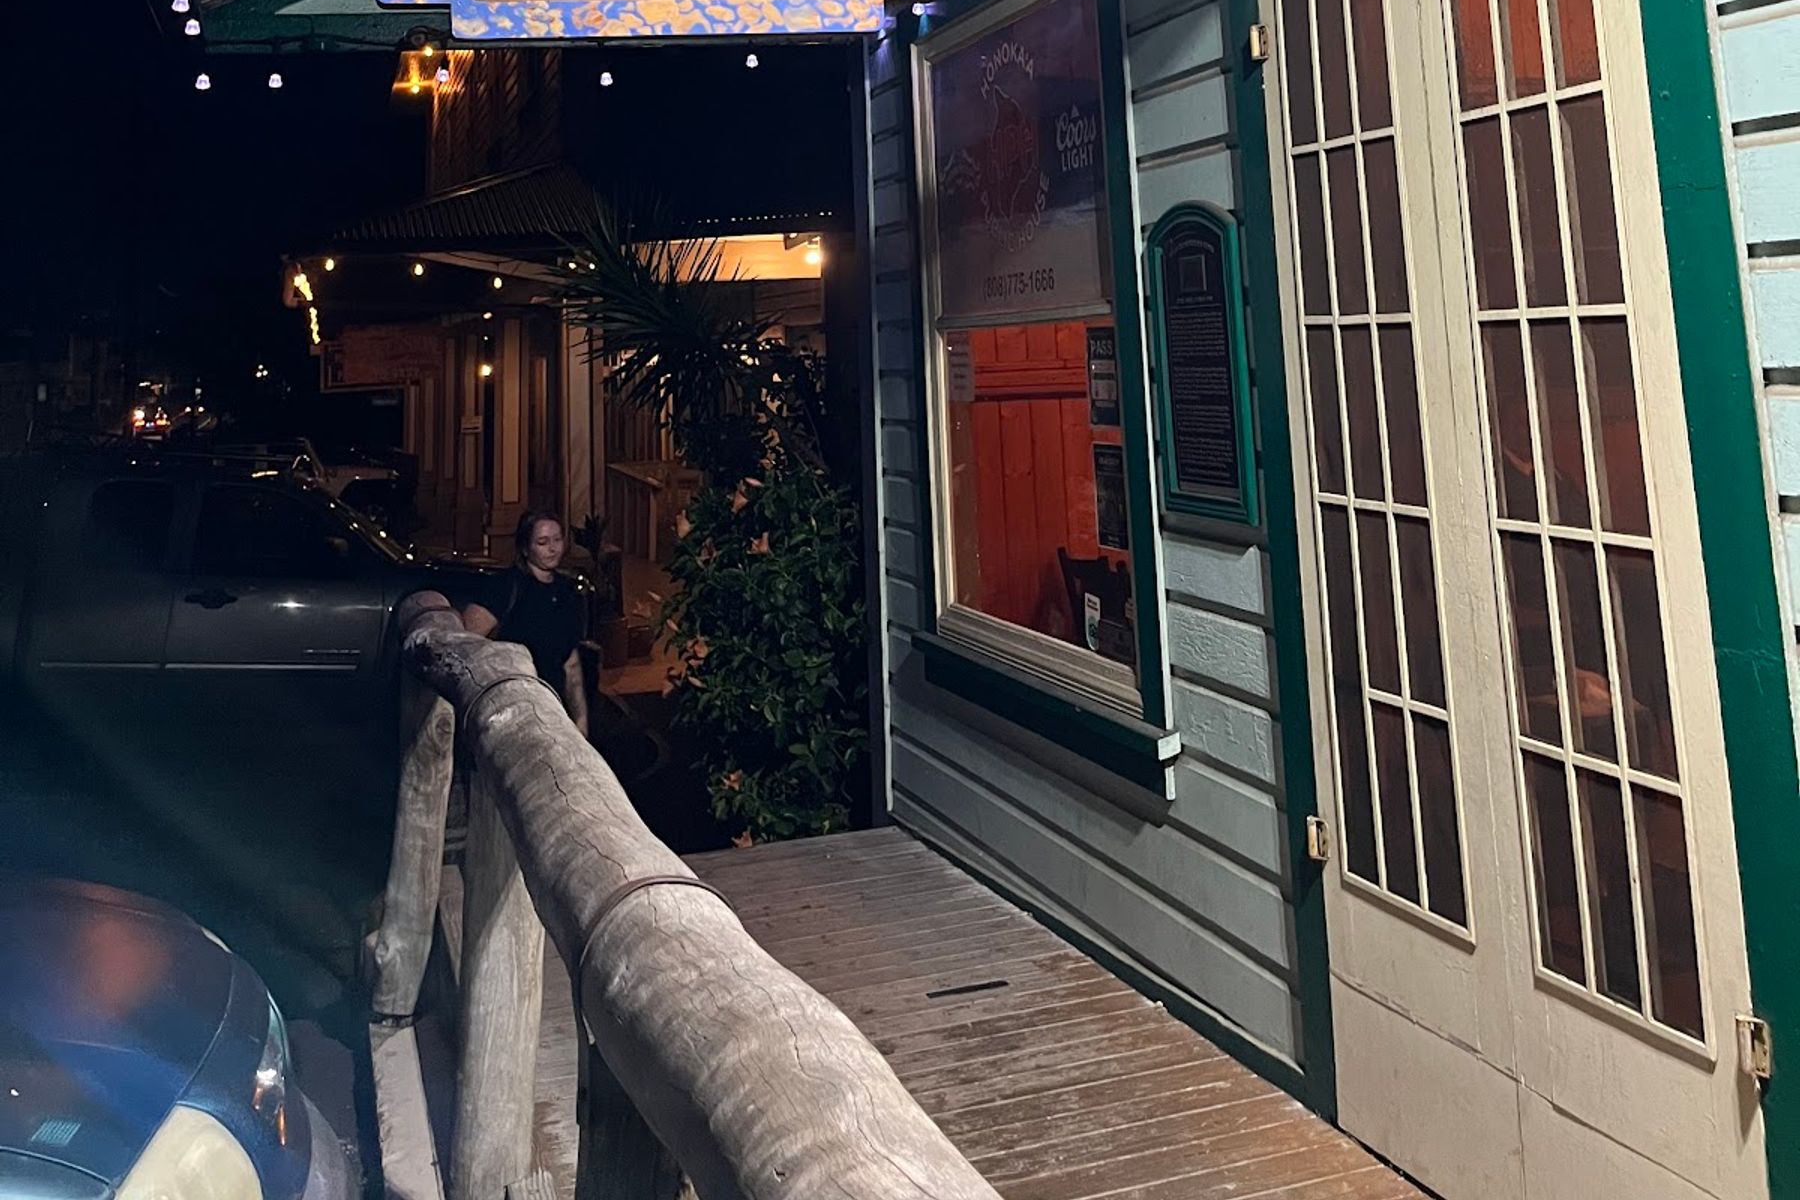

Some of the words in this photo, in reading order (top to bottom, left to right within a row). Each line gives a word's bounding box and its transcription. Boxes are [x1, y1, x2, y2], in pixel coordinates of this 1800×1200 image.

[1054, 111, 1097, 152] Coors
[1061, 144, 1095, 173] LIGHT
[1017, 171, 1050, 250] HOUSE
[1090, 339, 1113, 355] PASS
